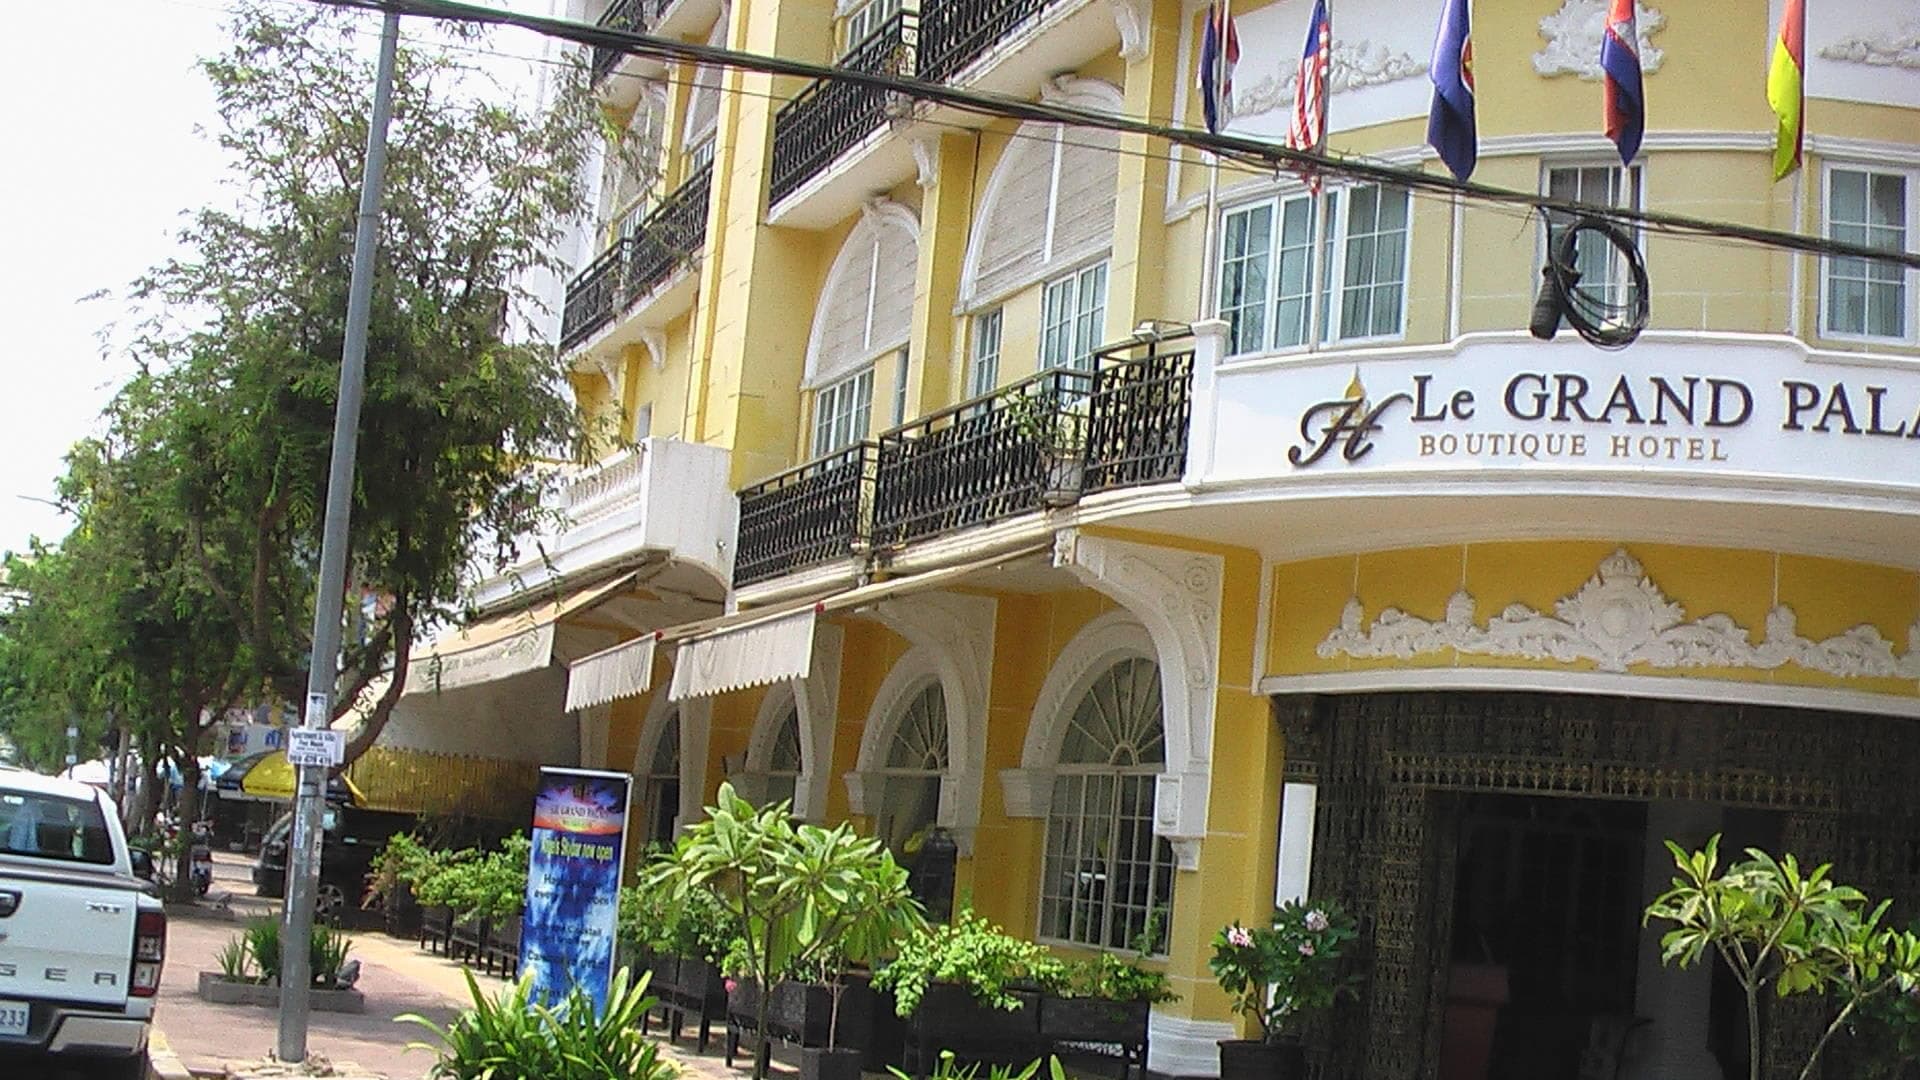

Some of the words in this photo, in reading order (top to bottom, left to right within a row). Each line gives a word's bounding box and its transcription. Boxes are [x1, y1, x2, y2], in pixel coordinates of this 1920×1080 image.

[1411, 374, 1475, 422] Le
[1503, 373, 1754, 428] GRAND
[1420, 432, 1587, 461] BOUTIQUE
[1611, 435, 1729, 461] HOTEL
[0, 1009, 25, 1026] 233
